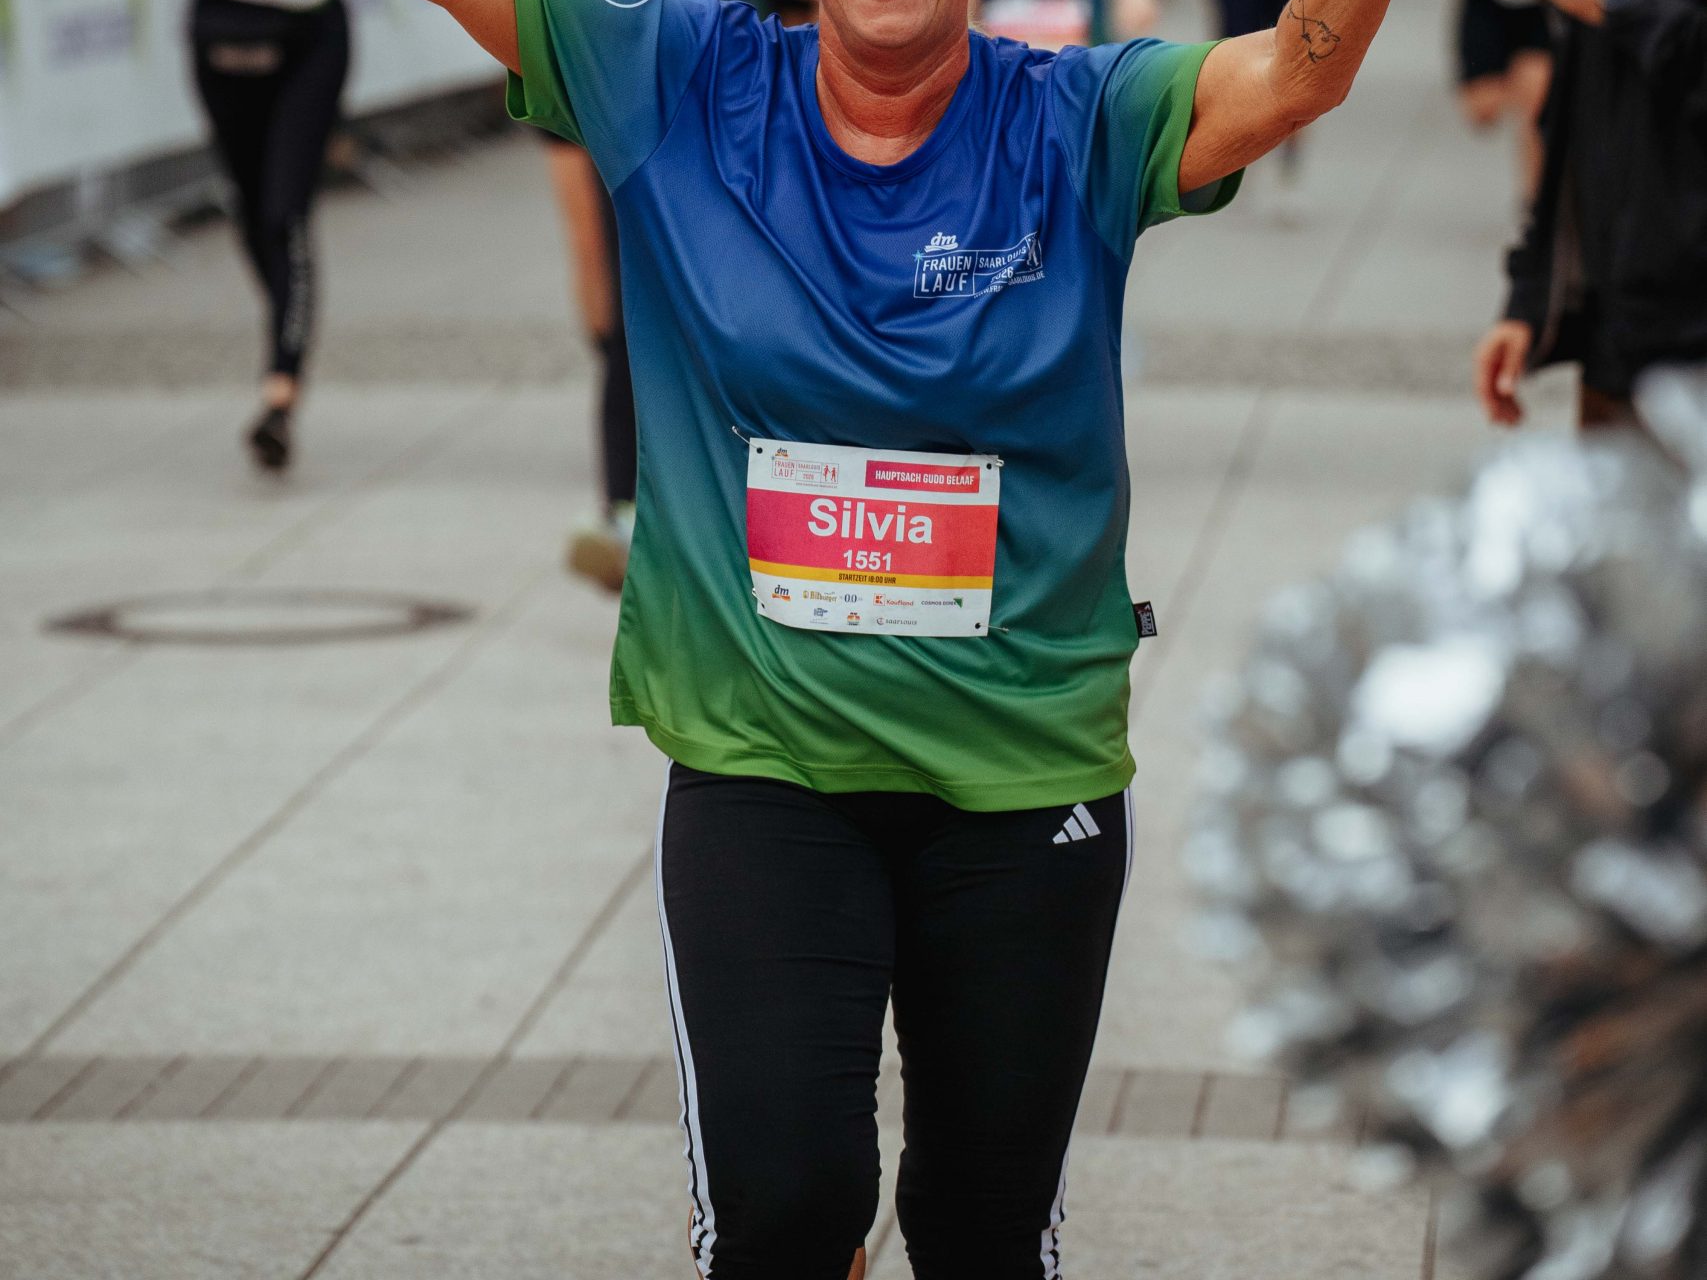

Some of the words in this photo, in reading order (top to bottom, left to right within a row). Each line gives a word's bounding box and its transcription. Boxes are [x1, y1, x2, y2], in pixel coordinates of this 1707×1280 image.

[930, 232, 957, 246] dm
[923, 256, 972, 271] FRAUEN
[979, 246, 1027, 269] SAARLOUIS
[921, 273, 969, 292] LAUF
[774, 460, 795, 469] FRAUEN
[774, 468, 795, 478] LAUF
[875, 469, 921, 483] HAUPTSACH
[922, 473, 945, 484] GUDD
[946, 475, 975, 486] GELAAF
[807, 498, 933, 544] Silvia
[843, 549, 892, 571] 1551
[838, 573, 867, 583] STARTZEIT
[883, 576, 897, 584] UHR
[774, 584, 789, 596] dm
